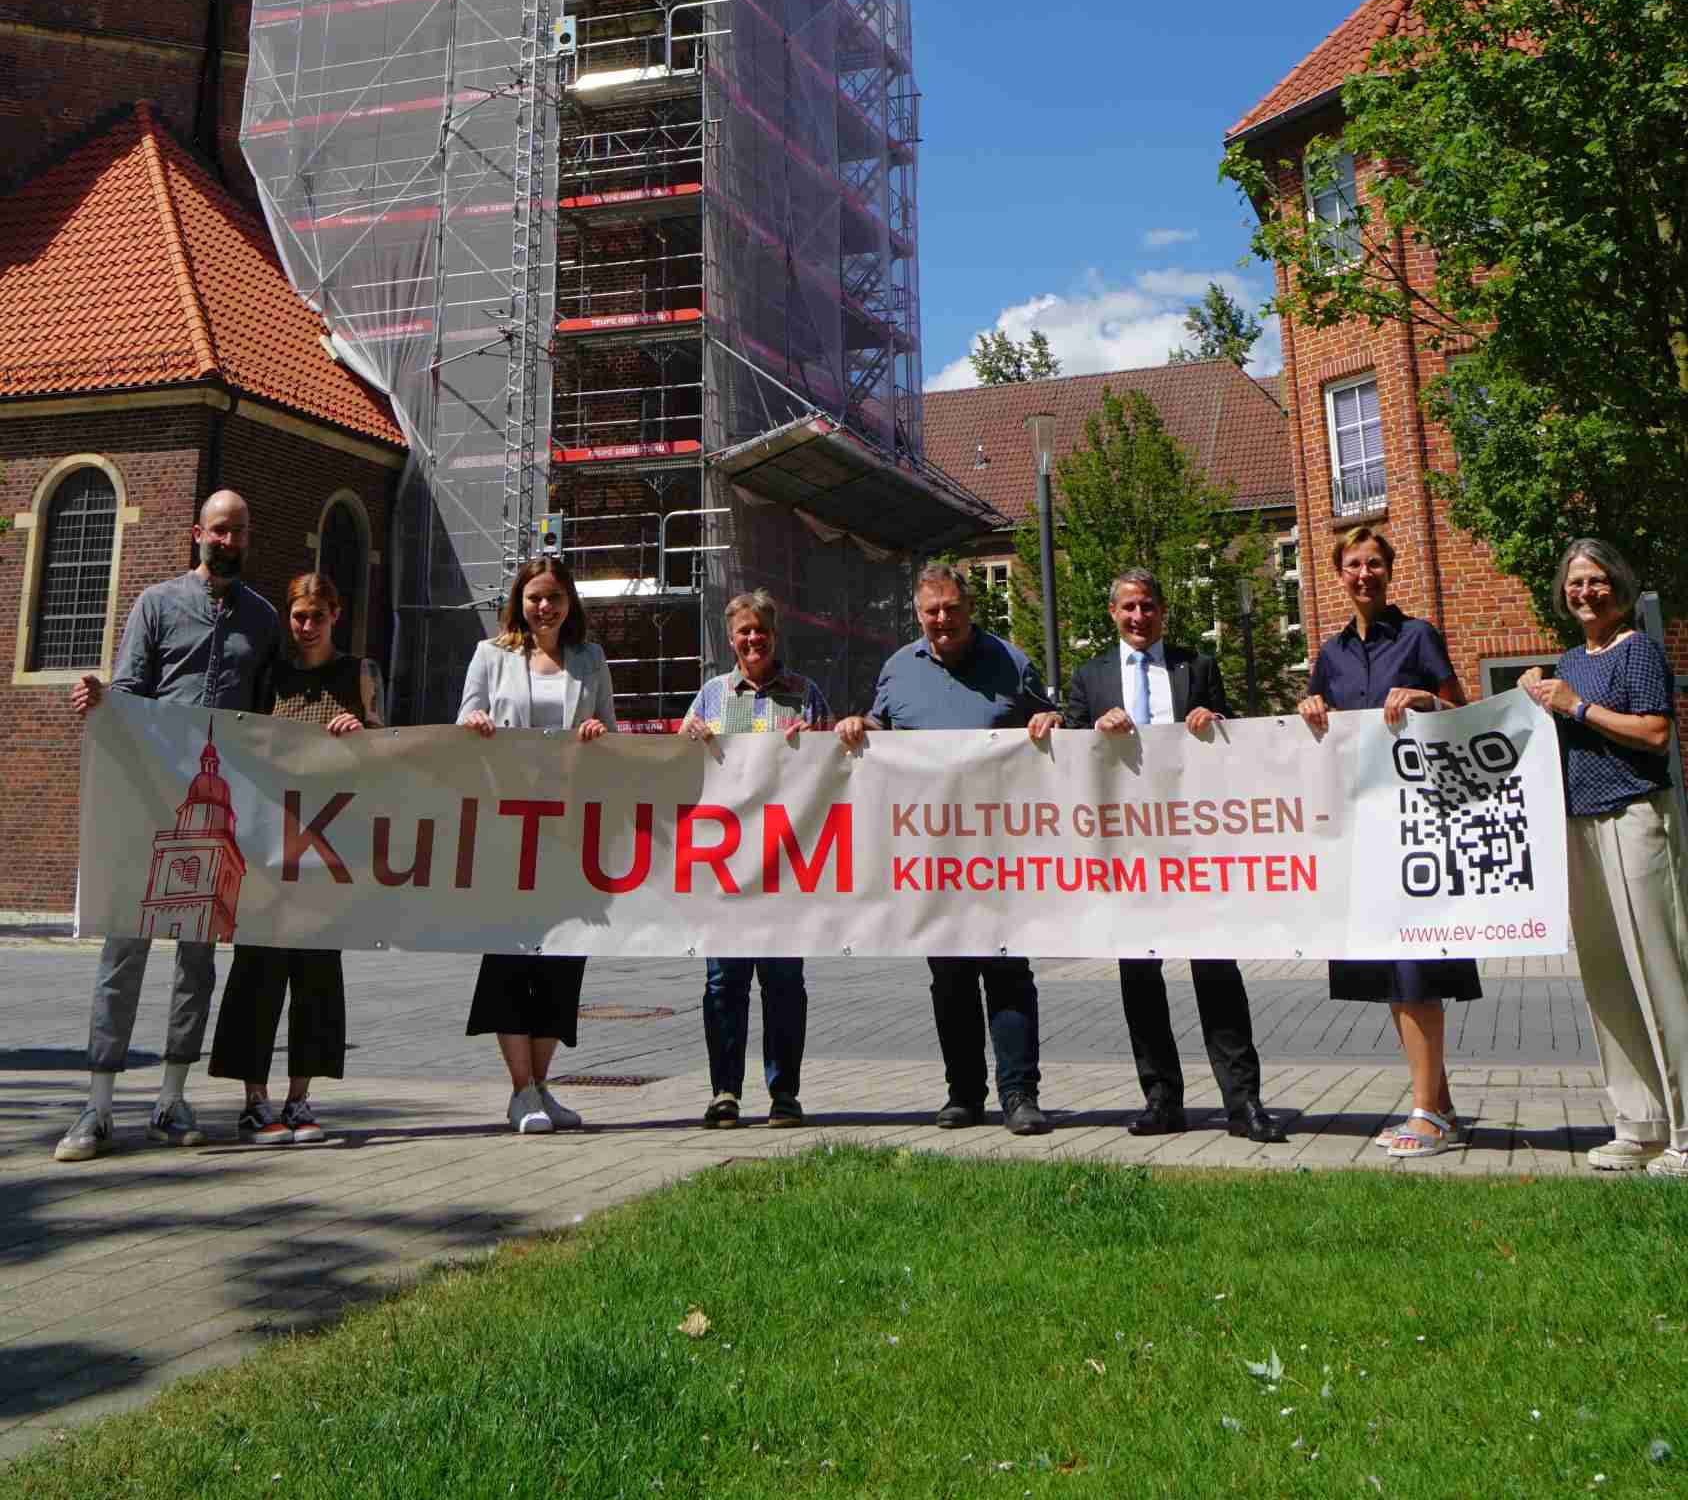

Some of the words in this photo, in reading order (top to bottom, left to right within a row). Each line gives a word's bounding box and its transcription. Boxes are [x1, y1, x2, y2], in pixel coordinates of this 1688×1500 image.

[892, 802, 1061, 837] KULTUR
[1072, 797, 1304, 838] GENIESSEN
[282, 790, 856, 896] KulTURM
[893, 855, 1147, 893] KIRCHTURM
[1158, 854, 1318, 893] RETTEN
[1399, 918, 1546, 942] www.ev-coe.de
